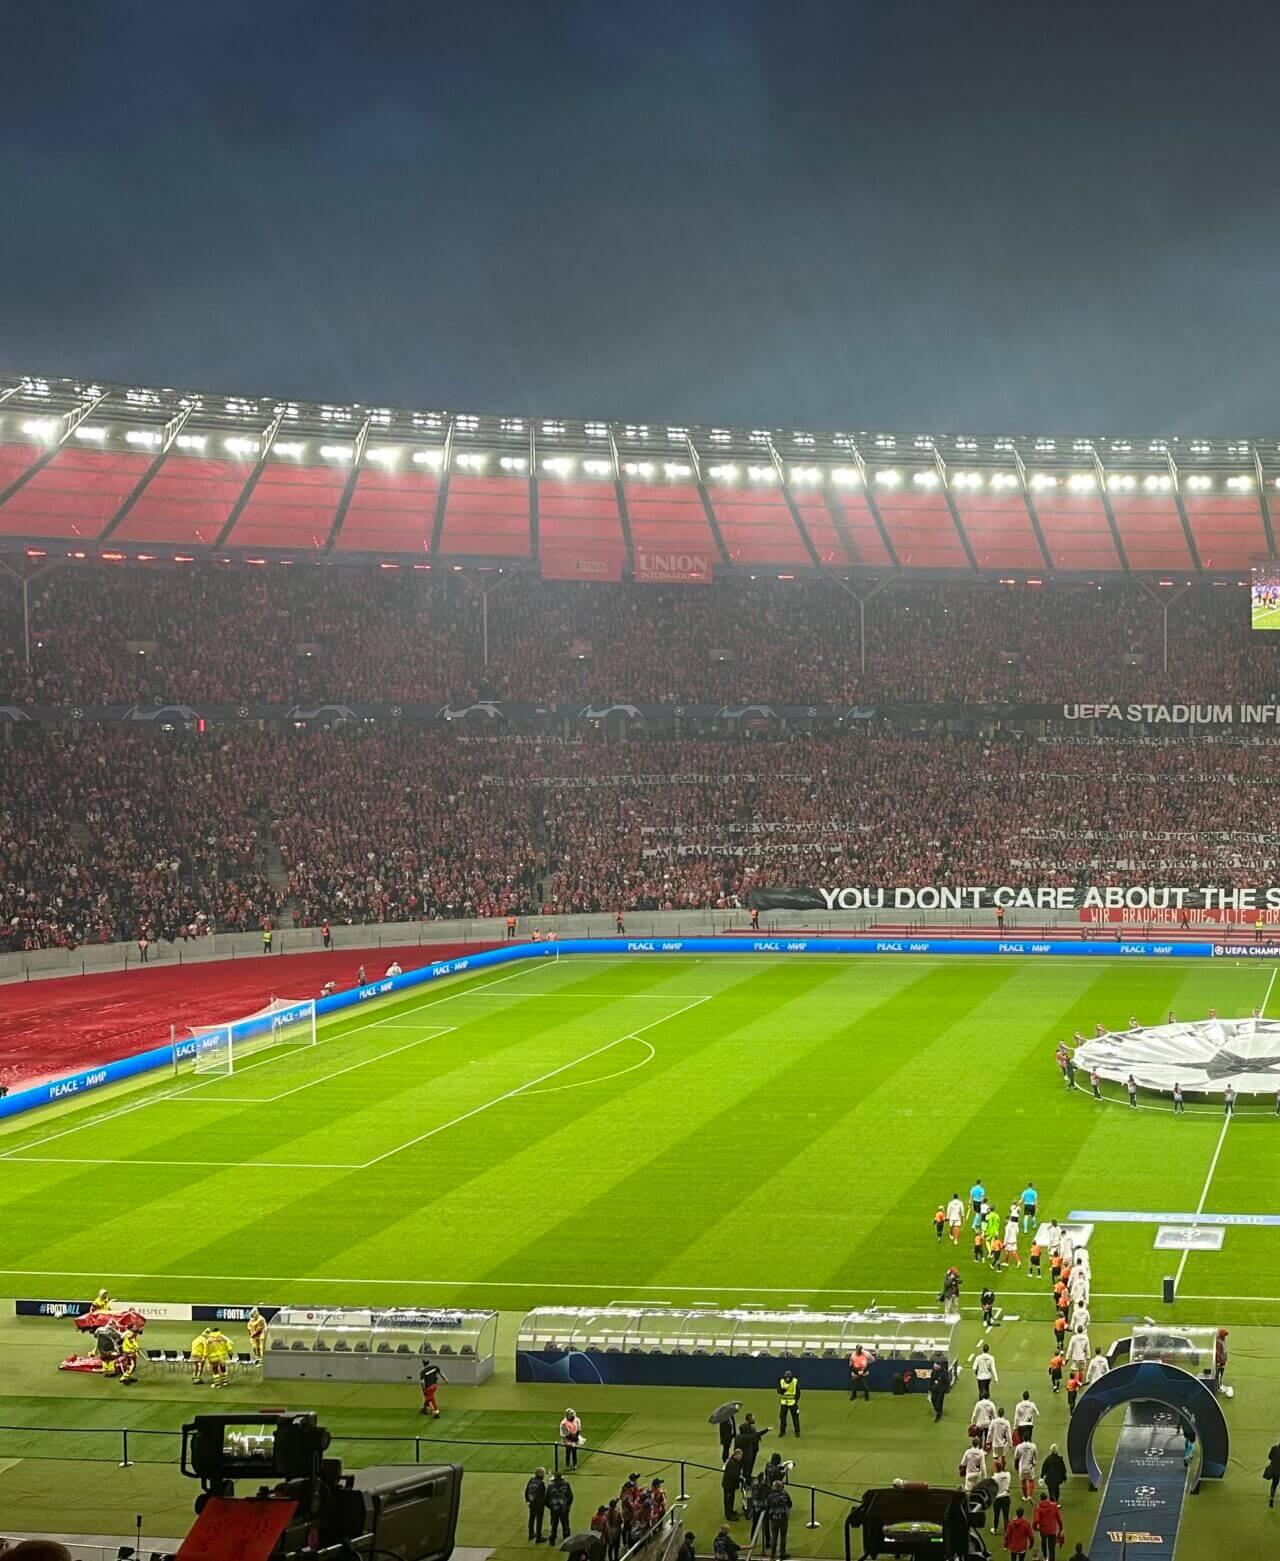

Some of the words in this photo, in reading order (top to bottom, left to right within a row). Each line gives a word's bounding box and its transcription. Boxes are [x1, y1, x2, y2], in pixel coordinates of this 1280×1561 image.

[639, 553, 708, 572] UNION
[1063, 704, 1123, 720] UEFA
[1127, 704, 1233, 723] STADIUM
[1145, 832, 1165, 841] AND
[742, 846, 756, 856] OF
[819, 888, 884, 910] YOU
[894, 887, 985, 909] DON'T
[994, 887, 1075, 909] CARE
[1083, 887, 1189, 909] ABOUT
[1200, 888, 1256, 910] THE
[1091, 908, 1110, 922] WIR
[1122, 909, 1178, 922] BRAUCHEN
[1189, 909, 1206, 922] DIE
[1219, 910, 1247, 923] ALTE
[627, 943, 655, 951] PEACE
[753, 943, 780, 951] PEACE
[876, 943, 903, 951] PEACE
[999, 944, 1024, 952] PEACE
[1120, 945, 1146, 953] PEACE
[1225, 947, 1248, 955] UEFA
[432, 964, 450, 976] PEACE
[359, 986, 377, 999] PEACE
[49, 1081, 79, 1098] PEACE
[85, 1071, 107, 1087] МИР
[39, 1303, 81, 1315] #FOOTBALL
[137, 1308, 168, 1316] RESPECT
